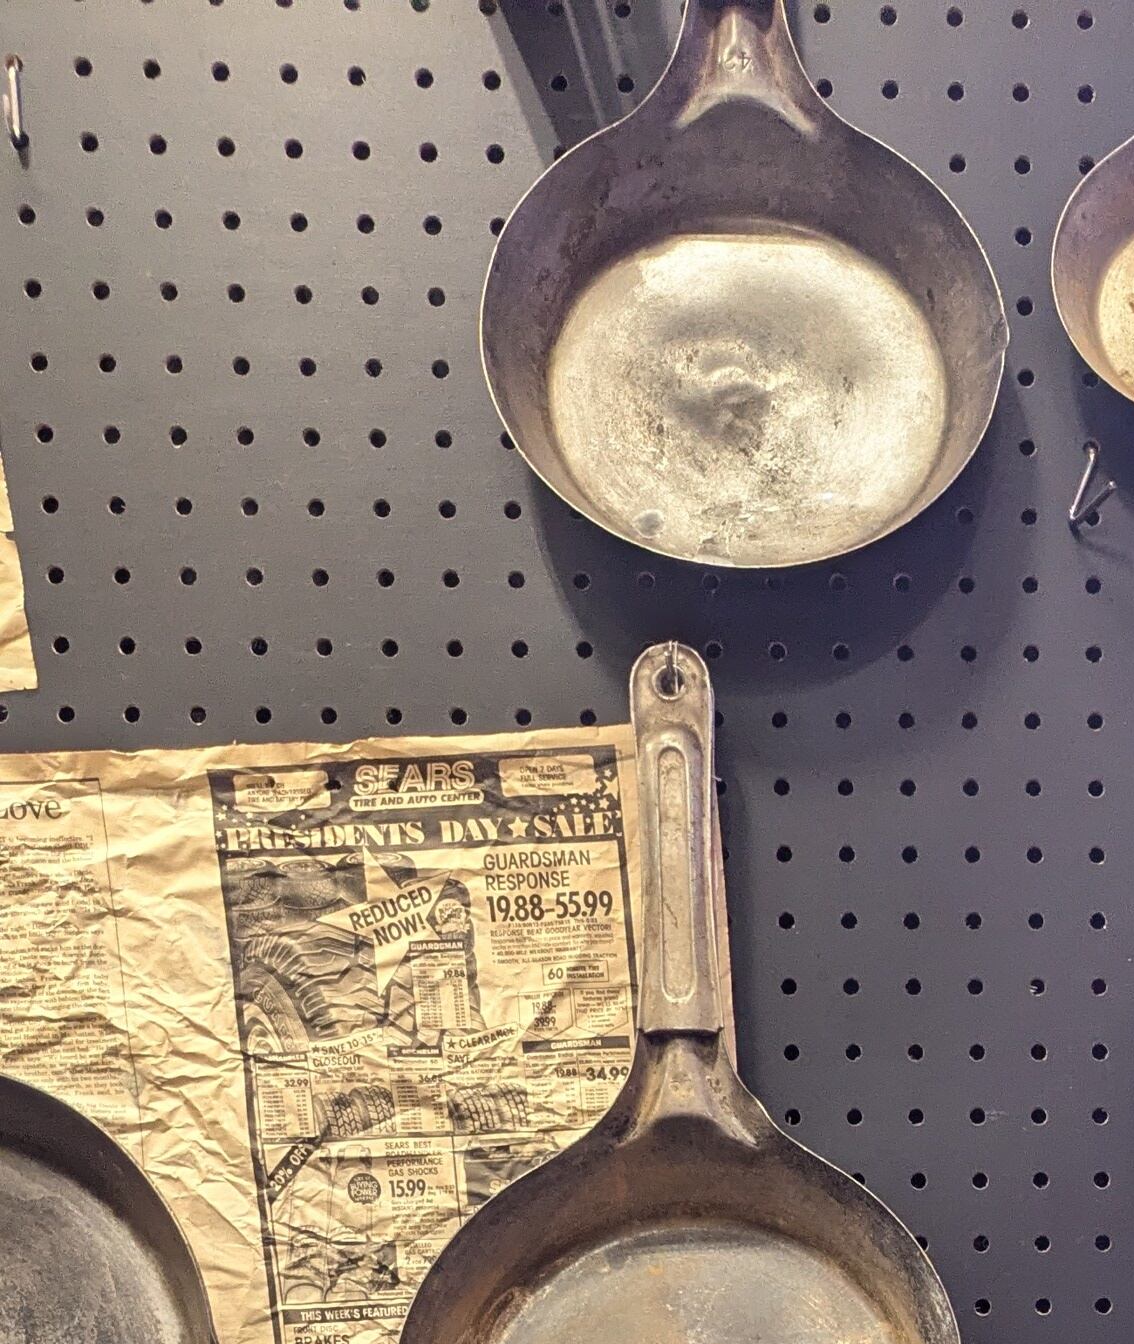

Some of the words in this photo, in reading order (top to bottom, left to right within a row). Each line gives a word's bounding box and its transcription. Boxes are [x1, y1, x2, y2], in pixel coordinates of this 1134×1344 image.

[354, 760, 476, 796] SEARS
[353, 797, 377, 807] TIRE
[381, 796, 403, 806] AND
[408, 794, 437, 804] AUTO
[441, 790, 481, 803] CENTER
[224, 820, 426, 850] PRESIDENTS
[439, 816, 503, 844] DAY
[533, 811, 615, 838] SALE
[484, 850, 591, 871] GUARDSMAN
[485, 871, 570, 892] RESPONSE
[349, 886, 432, 931] REDUCED
[486, 891, 613, 923] 19.88-55.99
[373, 912, 427, 946] NOW!
[547, 967, 564, 980] 60
[321, 1043, 346, 1056] SAVE
[551, 1039, 602, 1050] GUARDSMAN
[312, 1055, 362, 1068] CLOSEOUT
[585, 1066, 630, 1082] 34.99
[284, 1078, 309, 1088] 32.99
[385, 1141, 410, 1150] SEARS
[413, 1140, 432, 1149] BEST
[290, 1143, 308, 1167] OFF
[387, 1157, 444, 1167] PERFORMANCE
[388, 1168, 404, 1177] GAS
[408, 1167, 439, 1177] SHOCKS
[388, 1179, 426, 1198] 15.99
[300, 1311, 322, 1322] THIS
[325, 1308, 361, 1320] WEEK'S
[362, 1305, 409, 1318] FEATURED
[320, 1325, 339, 1333] DISC
